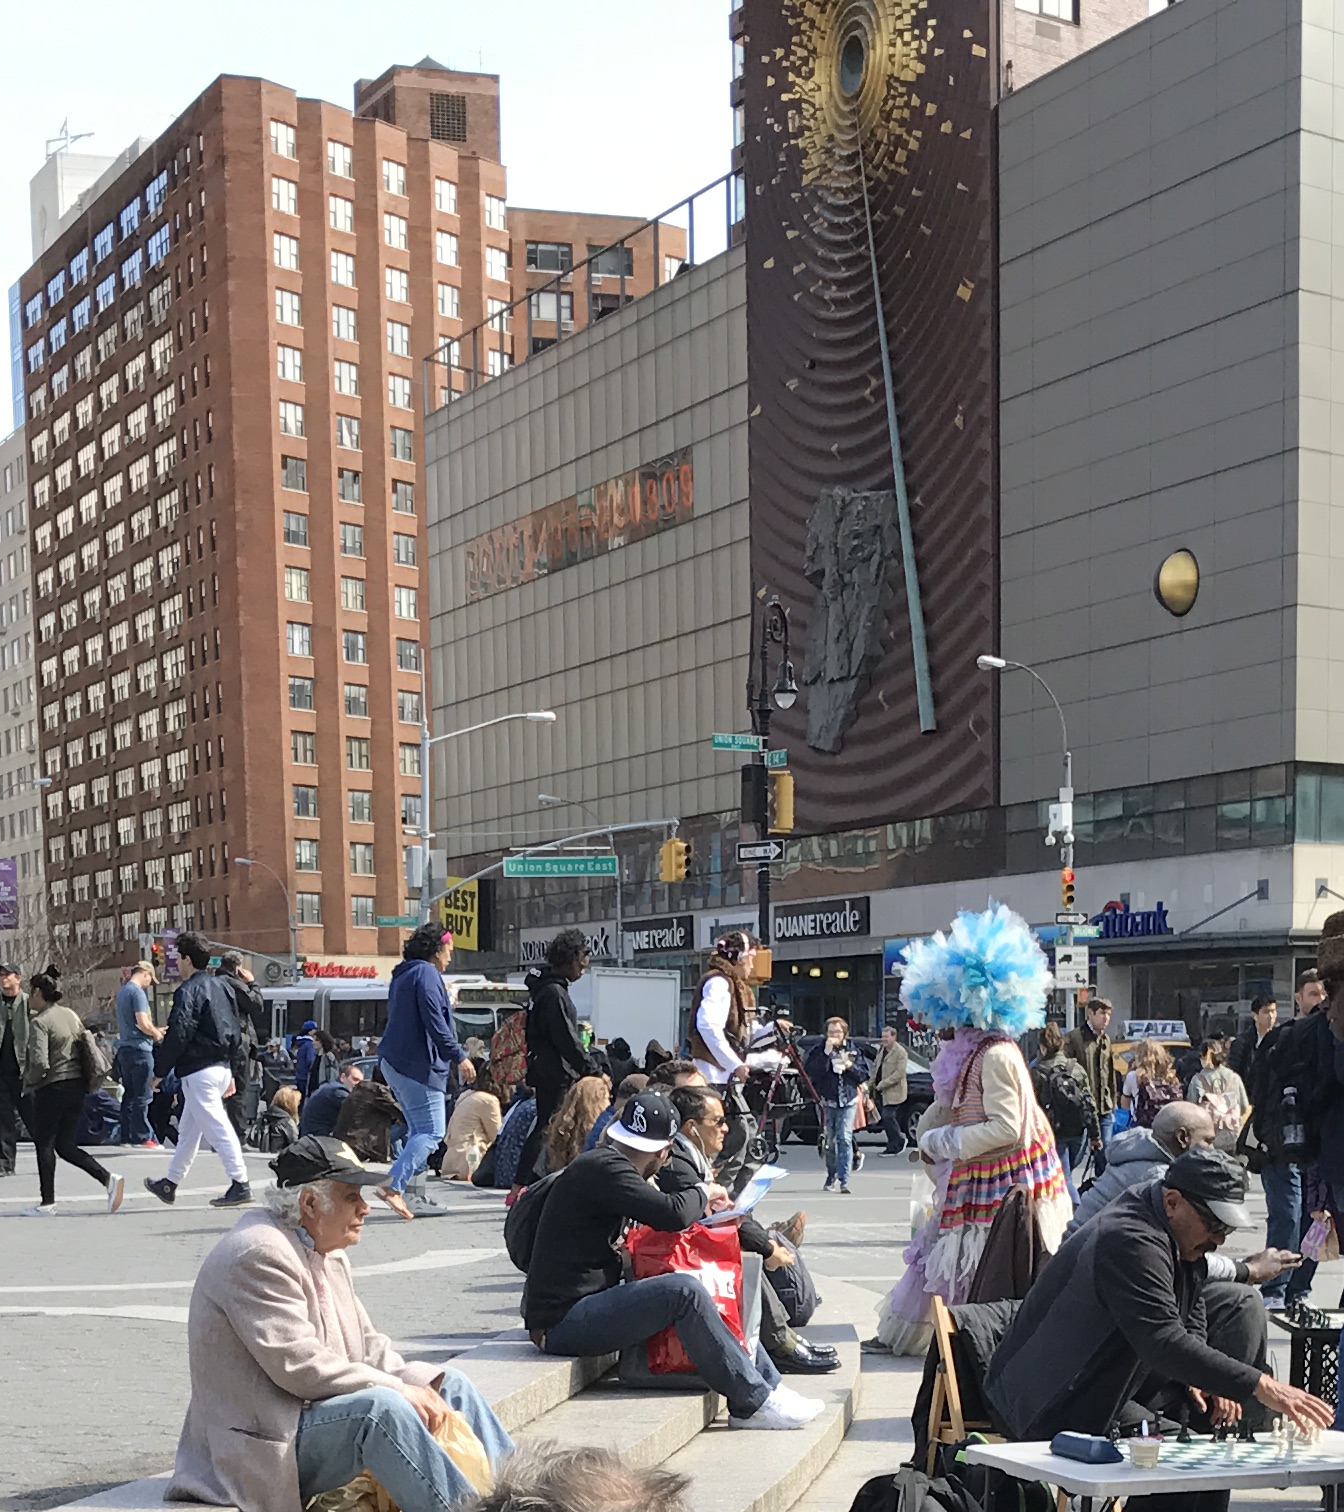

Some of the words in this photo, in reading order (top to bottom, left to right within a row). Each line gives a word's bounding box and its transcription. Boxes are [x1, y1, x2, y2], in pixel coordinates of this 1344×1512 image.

[743, 847, 757, 857] ONE
[762, 846, 776, 855] WAY
[508, 863, 542, 872] Union
[544, 862, 585, 874] Square
[587, 861, 613, 872] East
[444, 888, 476, 913] BEST
[445, 913, 474, 938] BUY
[1089, 900, 1169, 938] citibank
[302, 961, 379, 978] Walgreens
[1127, 1022, 1184, 1037] FATE
